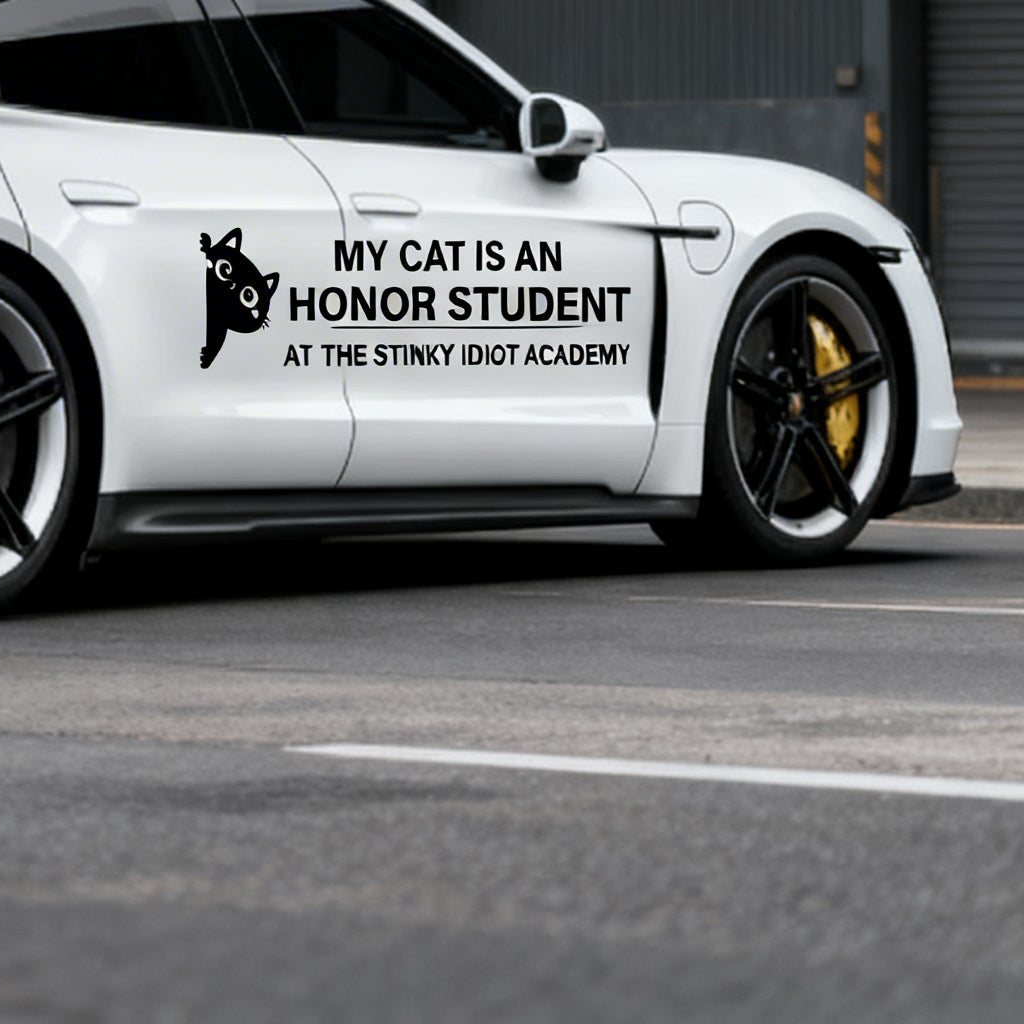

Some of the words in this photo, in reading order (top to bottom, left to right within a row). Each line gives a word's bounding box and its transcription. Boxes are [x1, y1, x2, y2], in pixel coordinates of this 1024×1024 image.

[334, 239, 389, 272] MY
[399, 239, 466, 273] CAT
[475, 239, 506, 272] IS
[514, 240, 563, 272] AN
[289, 286, 436, 322] HONOR
[447, 286, 632, 323] STUDENT
[283, 343, 314, 367] AT
[320, 343, 368, 368] THE
[372, 343, 456, 367] STINKY
[461, 343, 521, 366] IDIOT
[523, 343, 631, 366] ACADEMY
